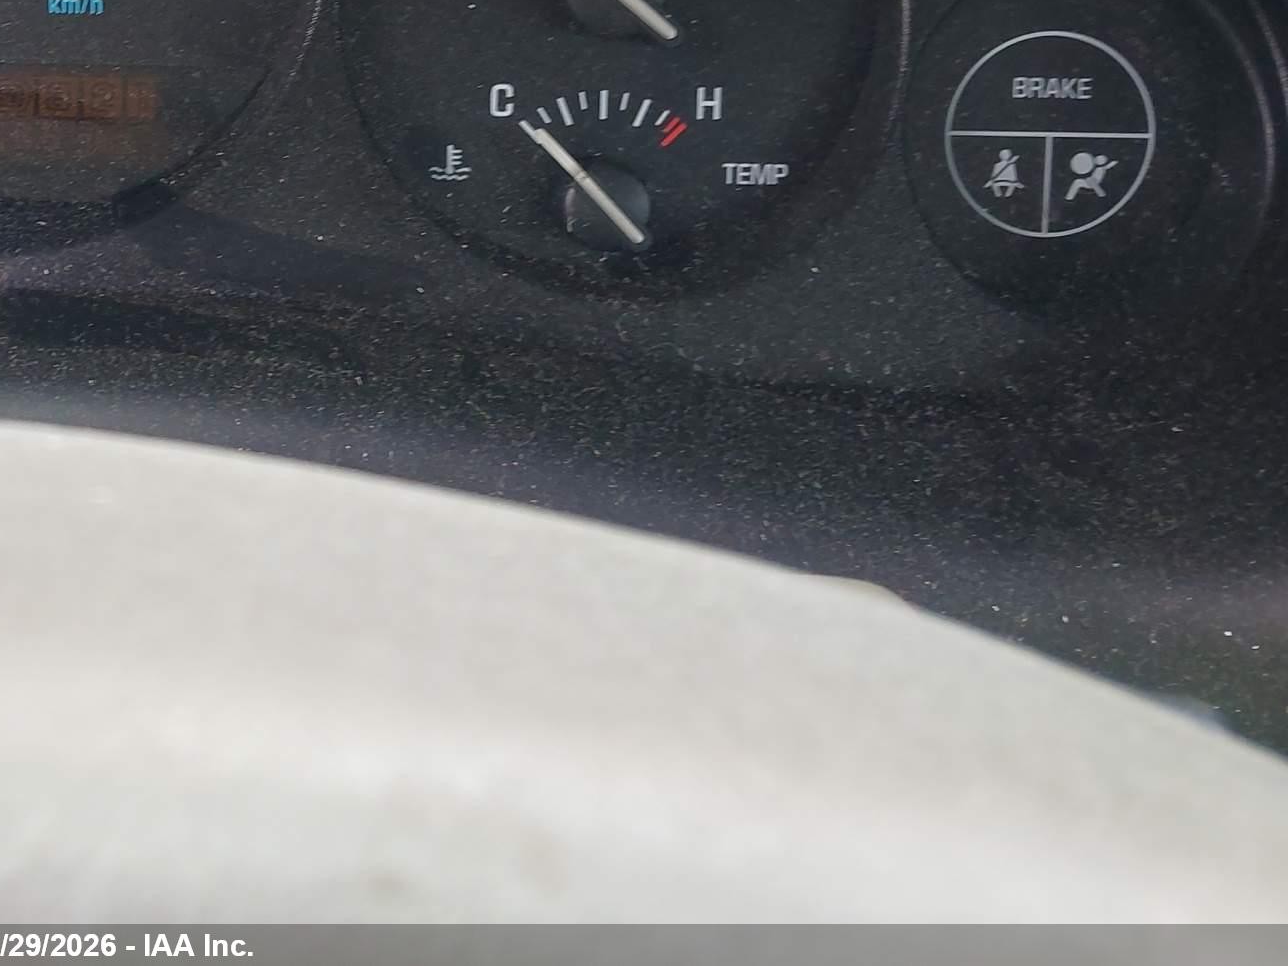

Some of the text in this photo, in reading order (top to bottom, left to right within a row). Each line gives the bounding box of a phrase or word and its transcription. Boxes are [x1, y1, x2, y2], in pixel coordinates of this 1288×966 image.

[489, 84, 515, 117] C
[1012, 77, 1093, 100] BRAKE
[696, 87, 722, 120] H
[723, 164, 788, 185] TEMP
